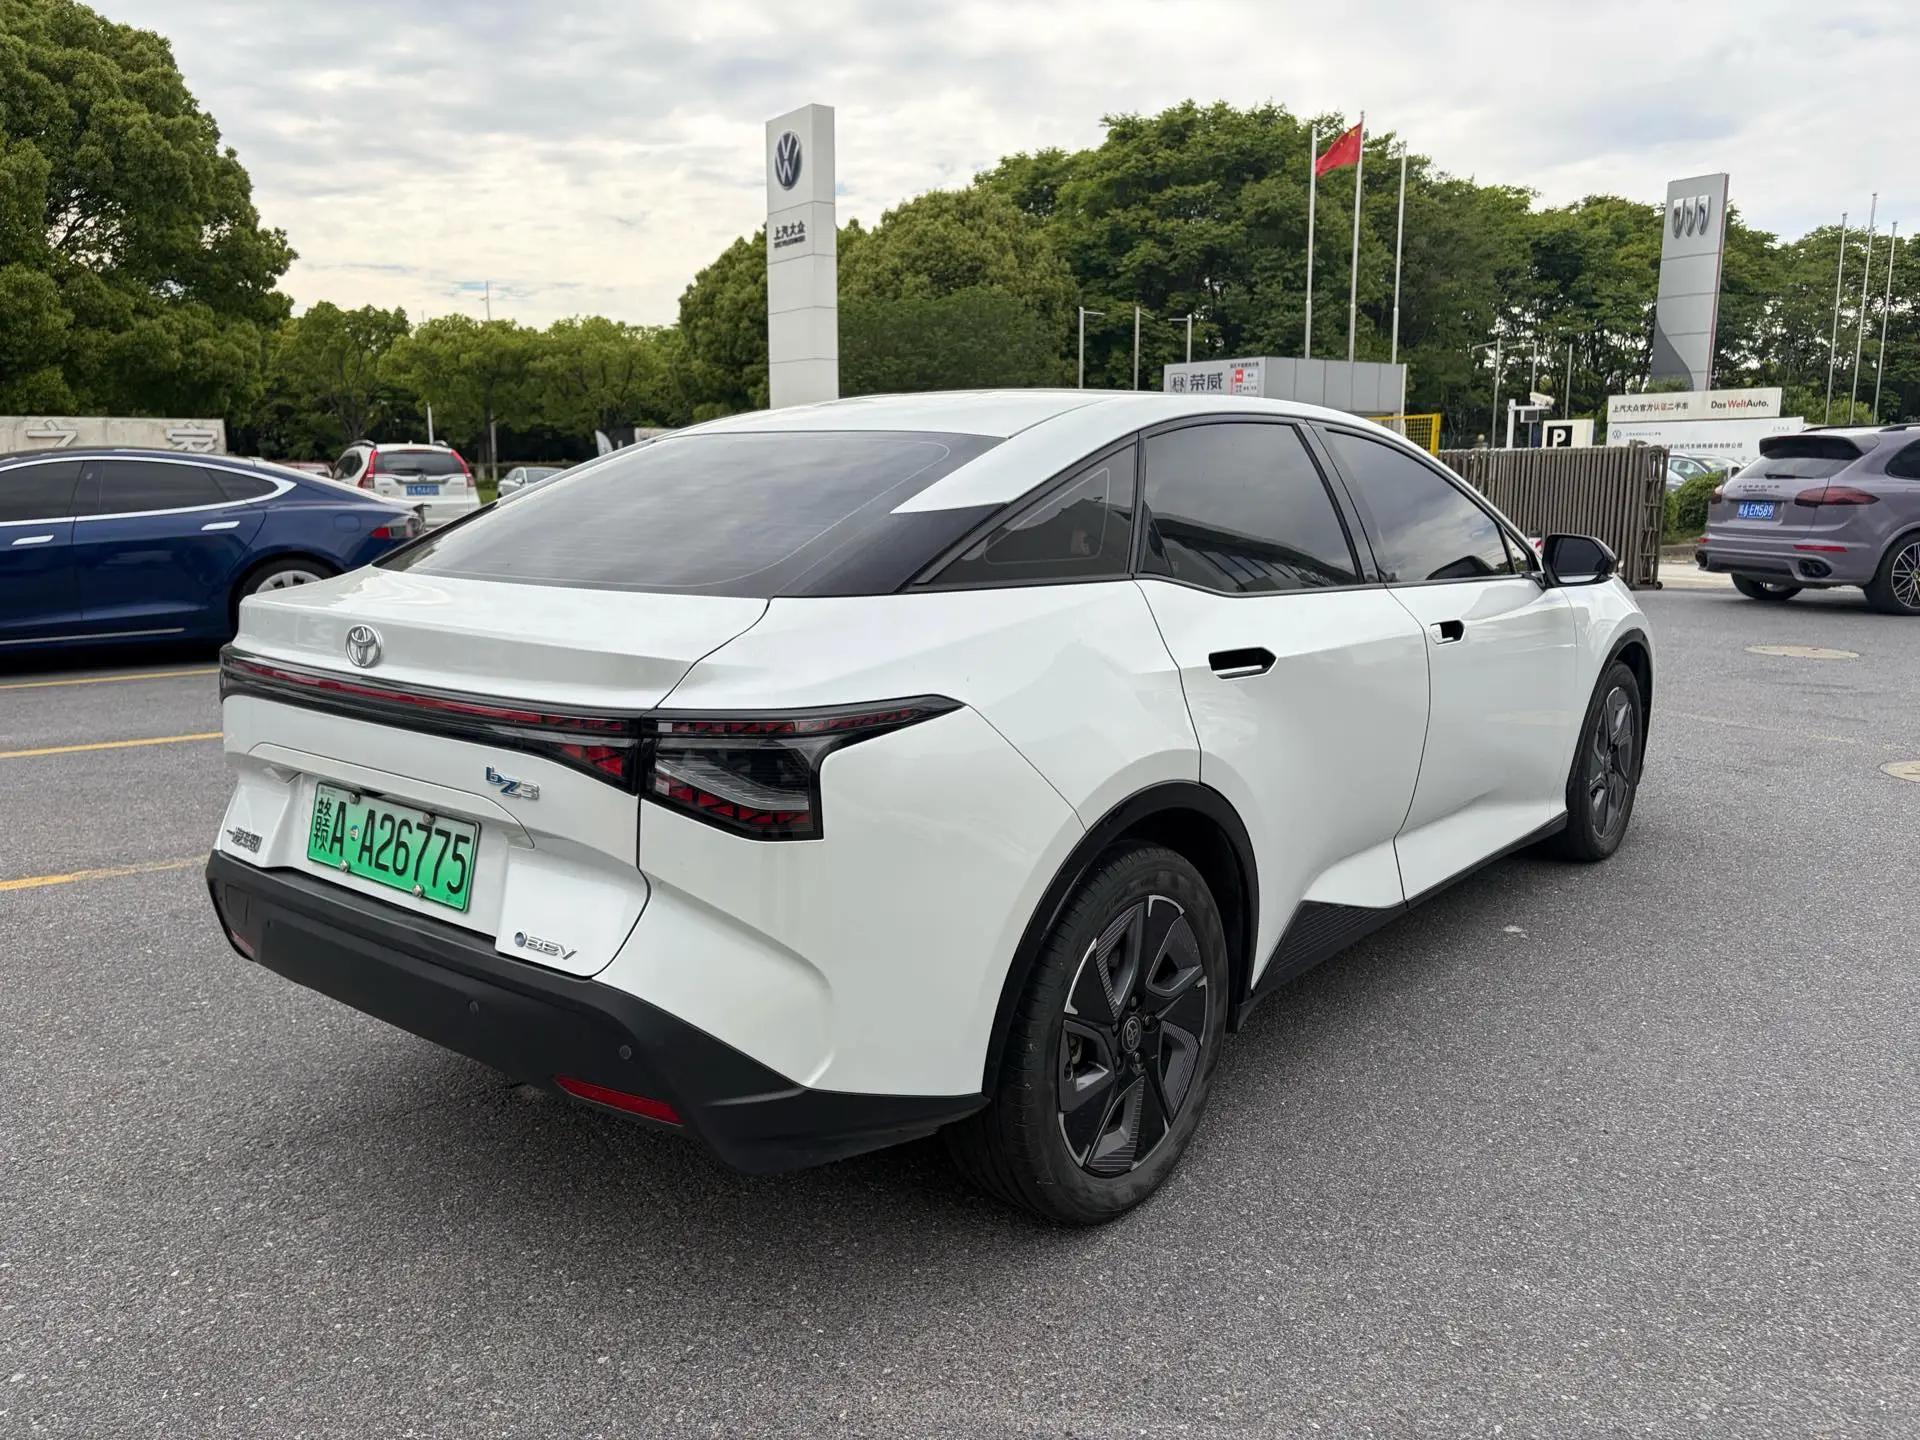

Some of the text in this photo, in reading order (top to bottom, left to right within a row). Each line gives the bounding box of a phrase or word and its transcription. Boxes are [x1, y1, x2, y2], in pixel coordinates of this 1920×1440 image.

[773, 220, 806, 240] 上汽大众
[1190, 372, 1223, 391] 荣威
[1612, 402, 1689, 413] 上汽大众官方认证二手车
[1711, 401, 1727, 409] Das
[1553, 429, 1566, 447] P
[485, 766, 540, 801] bZ3
